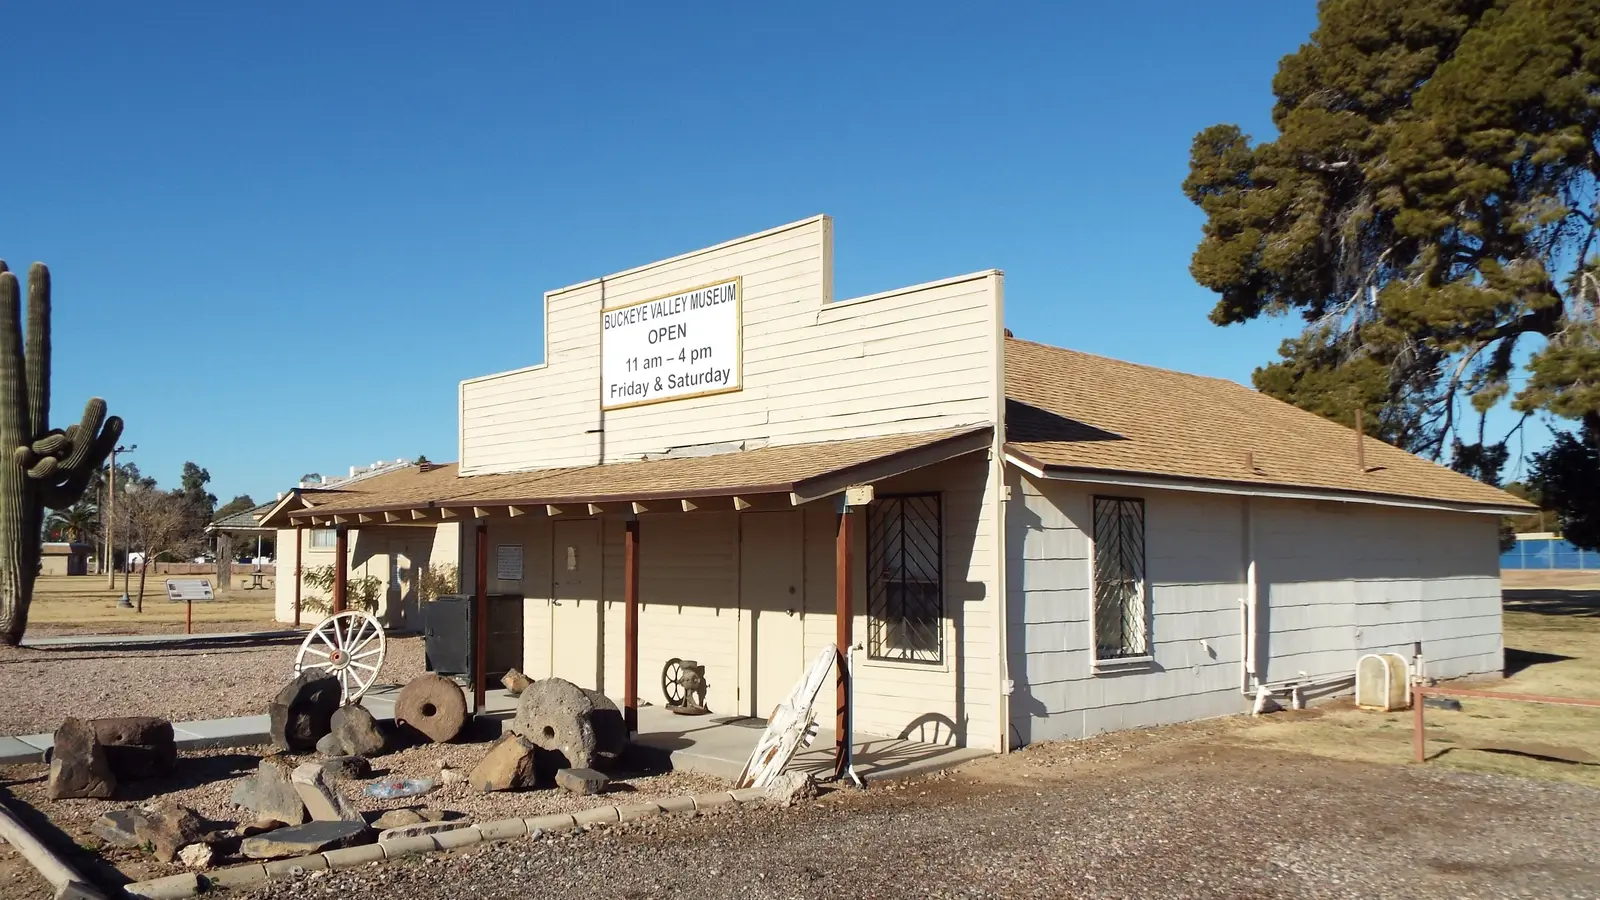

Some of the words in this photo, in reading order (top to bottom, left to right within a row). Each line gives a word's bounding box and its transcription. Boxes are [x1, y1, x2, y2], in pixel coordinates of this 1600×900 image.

[604, 305, 648, 330] BUCKEYE
[650, 295, 688, 319] VALLEY
[690, 283, 736, 310] MUSEUM
[648, 322, 687, 344] OPEN
[626, 357, 638, 372] 11
[643, 355, 662, 370] am
[678, 347, 686, 362] 4
[690, 345, 712, 365] pm
[610, 380, 649, 398] Friday
[654, 376, 663, 391] &
[667, 367, 731, 390] Saturday
